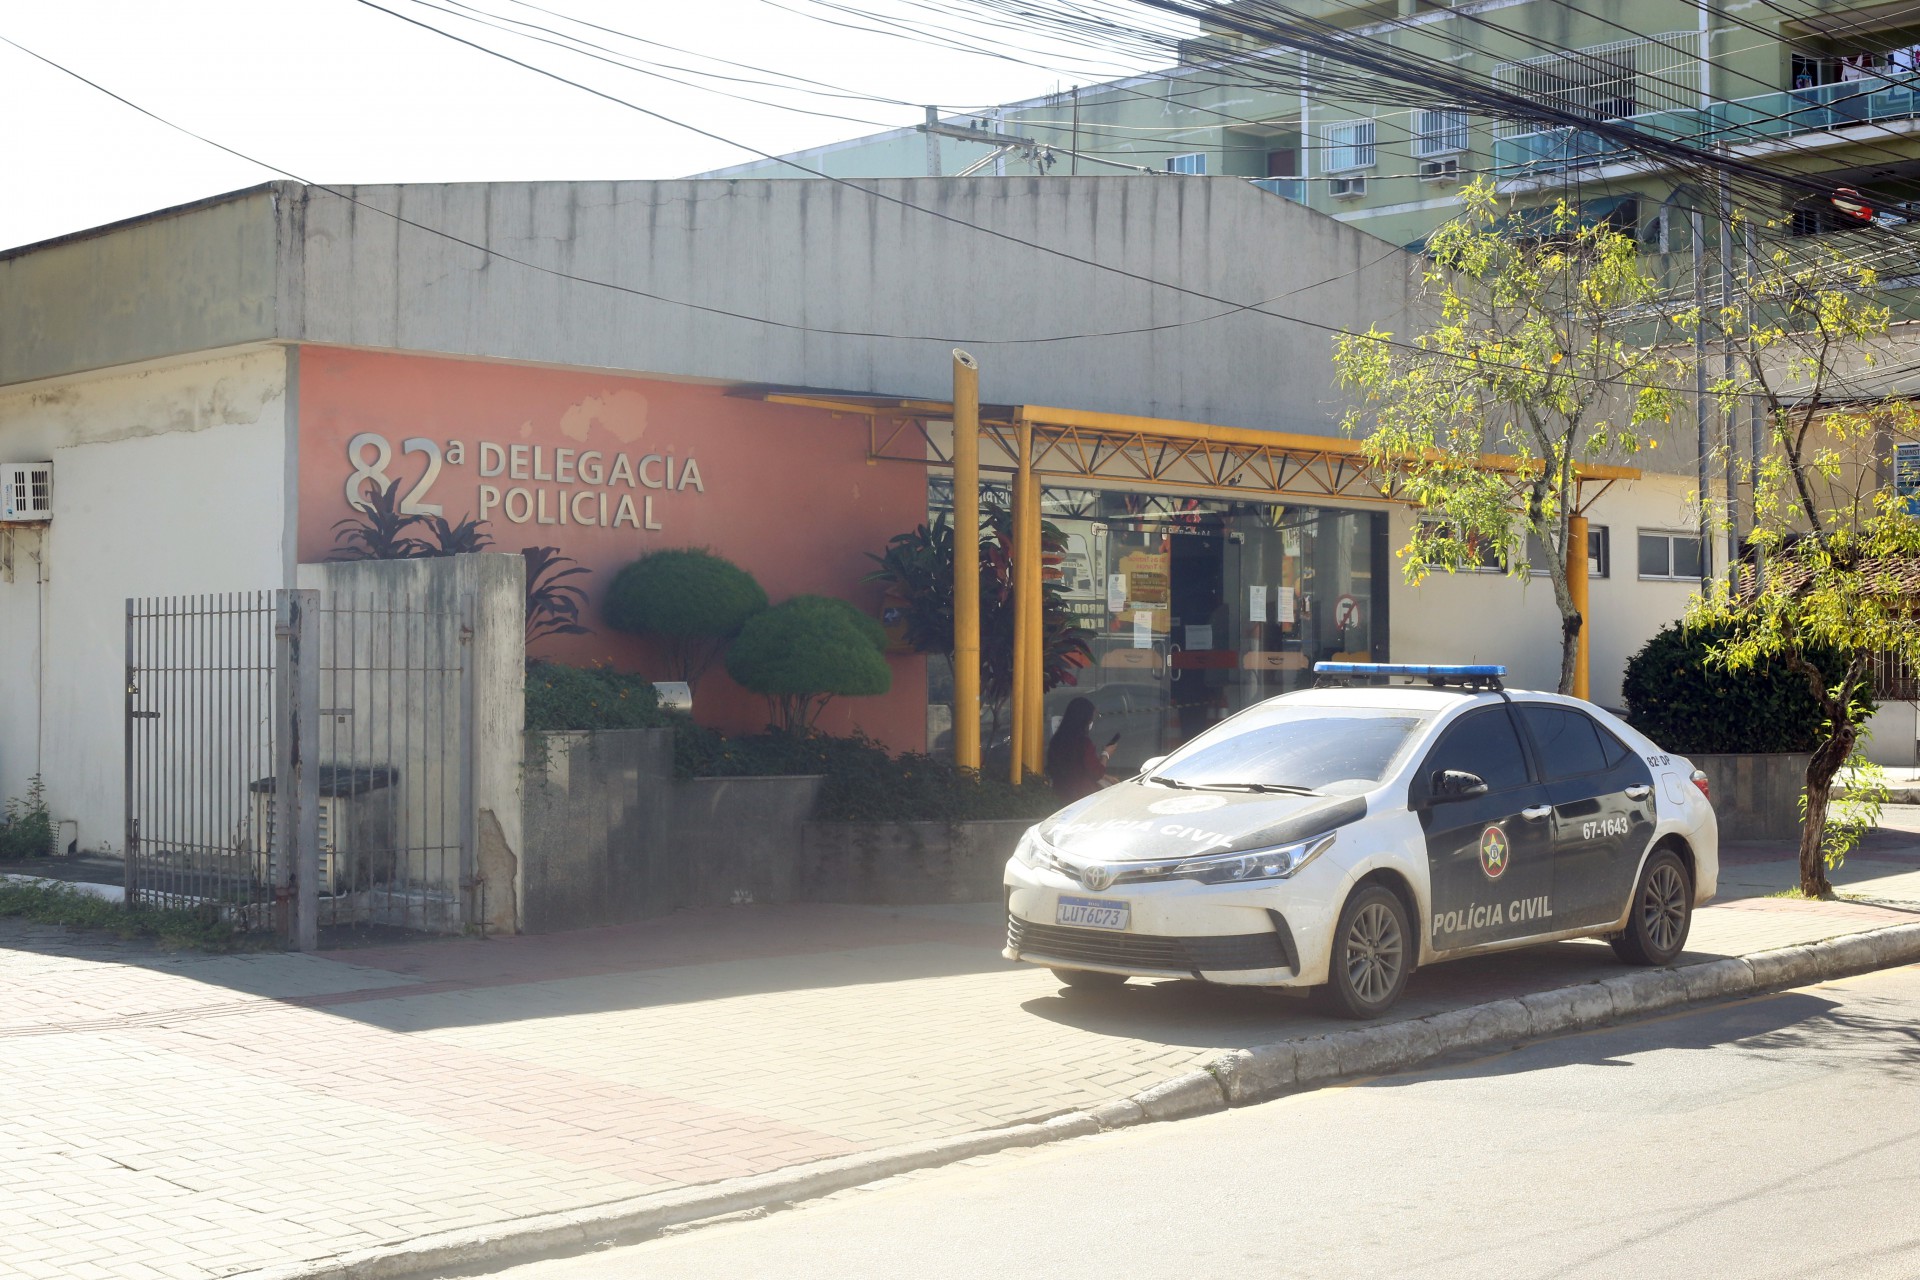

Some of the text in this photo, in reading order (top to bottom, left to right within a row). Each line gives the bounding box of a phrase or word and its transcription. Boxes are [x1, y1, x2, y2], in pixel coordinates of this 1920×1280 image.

[478, 441, 705, 492] DELEGACIA
[478, 484, 663, 530] POLICIAL
[1660, 754, 1671, 766] DP
[1159, 824, 1233, 849] CIVIL
[1583, 817, 1628, 839] 67-1643
[1062, 905, 1121, 926] LUT6C73
[1432, 895, 1553, 936] POLÍCIA CIVIL
